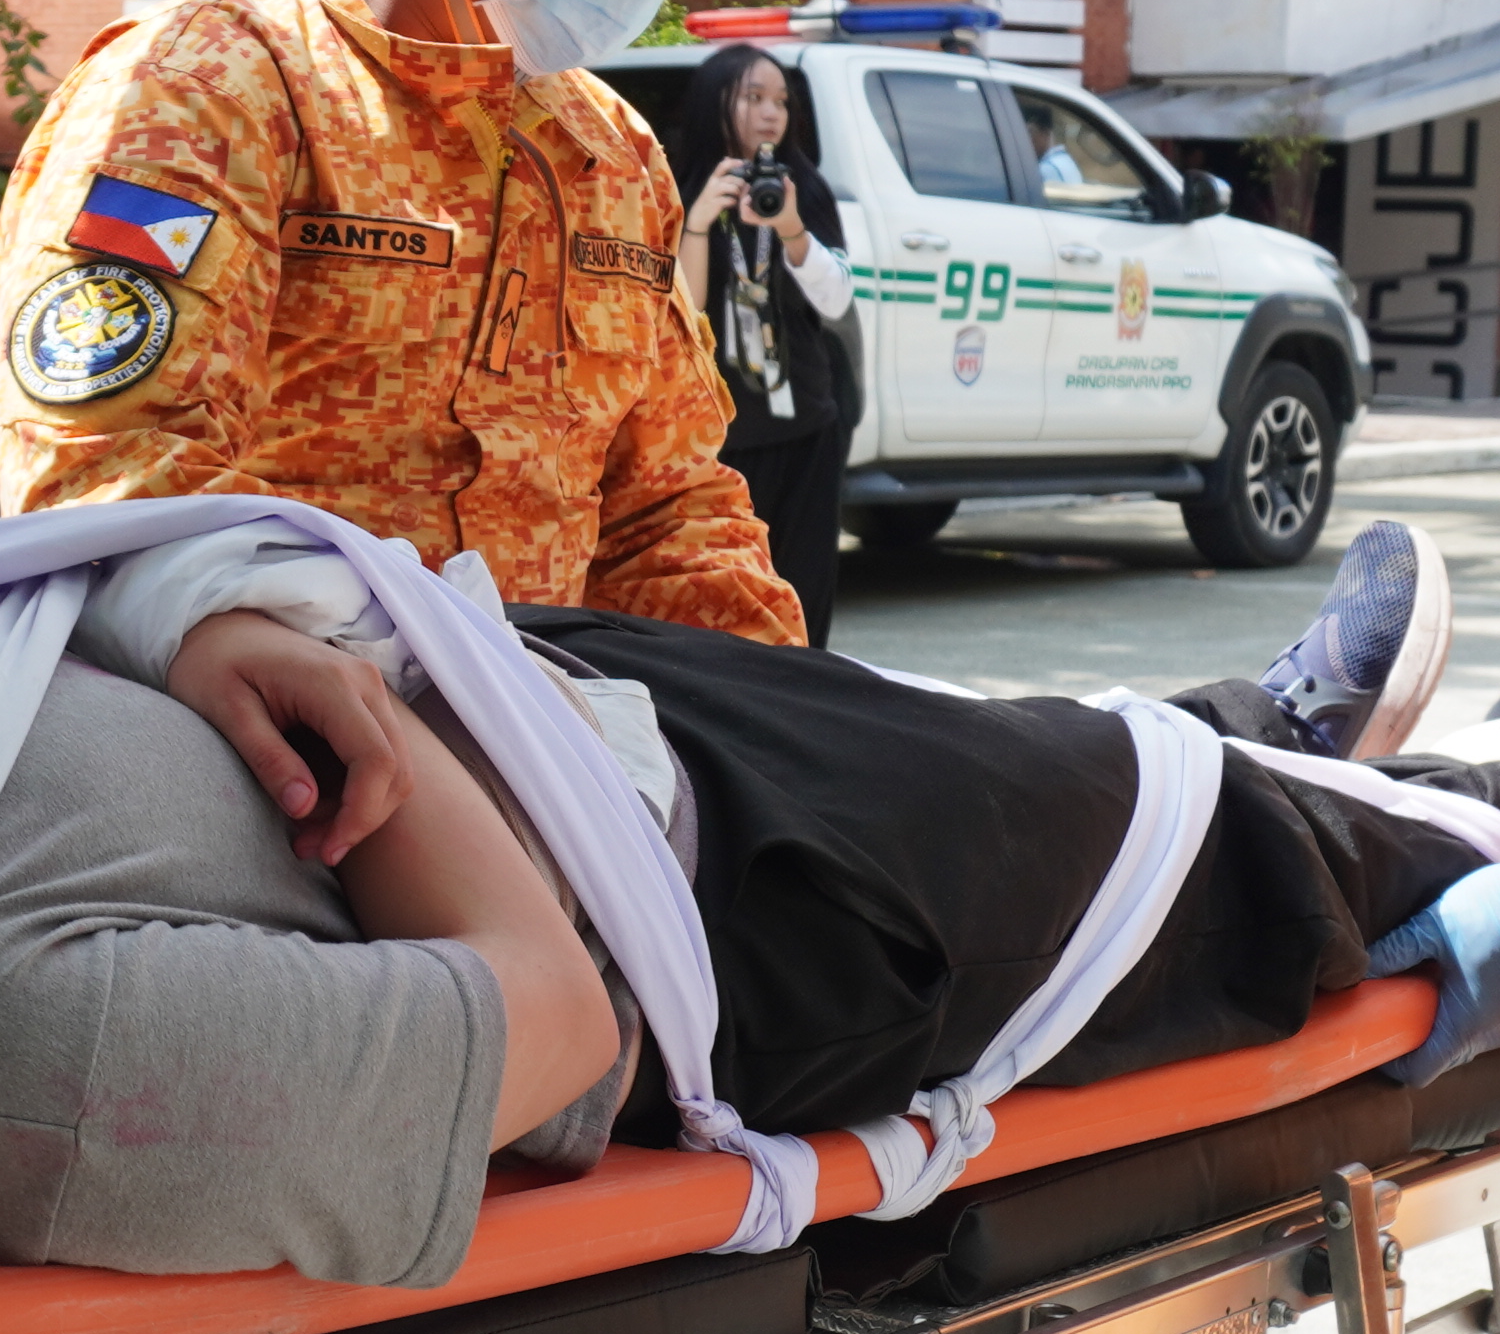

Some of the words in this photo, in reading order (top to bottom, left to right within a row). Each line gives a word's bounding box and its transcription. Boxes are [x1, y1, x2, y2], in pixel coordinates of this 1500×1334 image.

[299, 222, 428, 255] SANTOS
[65, 268, 89, 282] OF
[95, 266, 131, 280] FIRE
[940, 260, 1011, 322] 99
